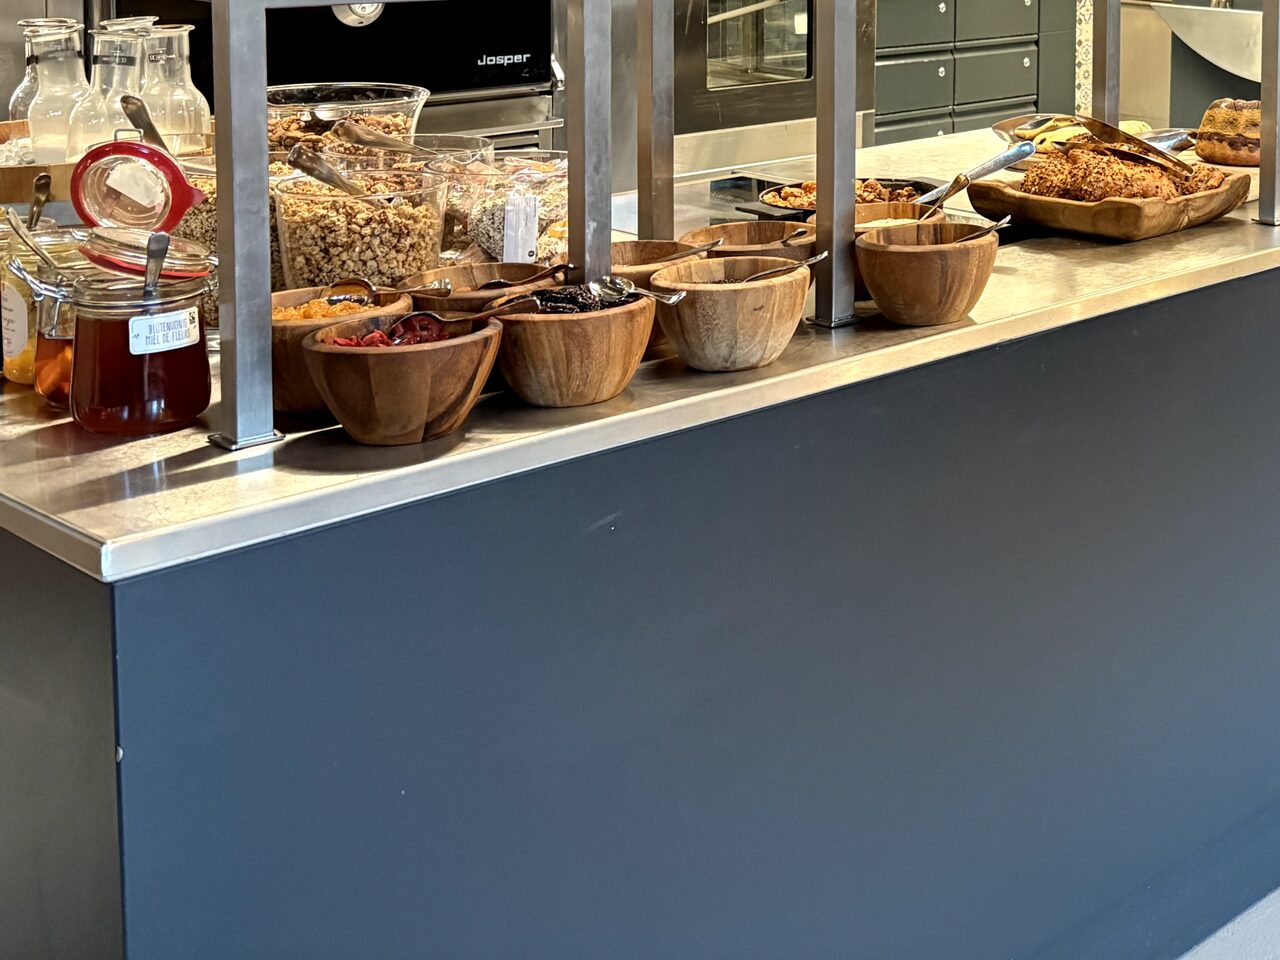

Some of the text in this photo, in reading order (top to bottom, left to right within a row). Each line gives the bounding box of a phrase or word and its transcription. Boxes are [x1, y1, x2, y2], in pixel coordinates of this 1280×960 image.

[478, 54, 531, 66] Josper
[145, 334, 160, 346] MIEL
[162, 333, 170, 344] DE
